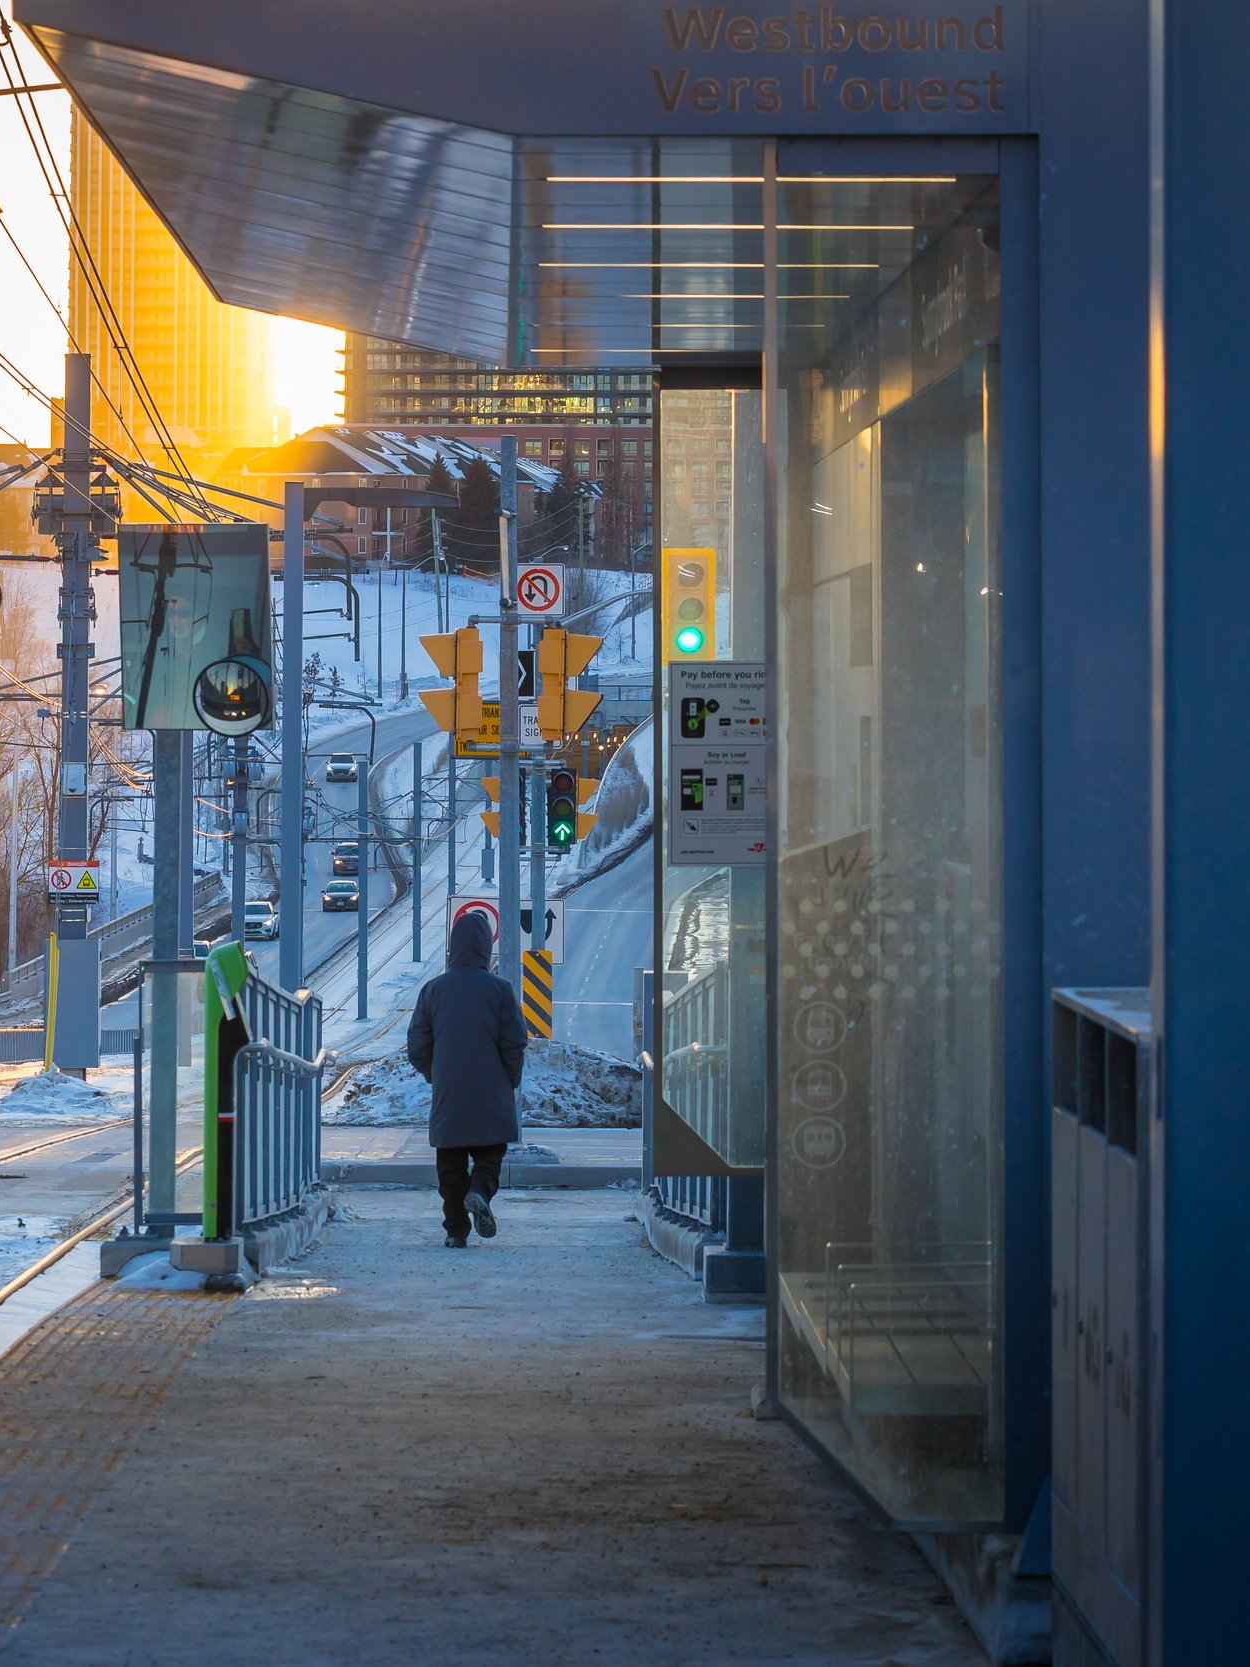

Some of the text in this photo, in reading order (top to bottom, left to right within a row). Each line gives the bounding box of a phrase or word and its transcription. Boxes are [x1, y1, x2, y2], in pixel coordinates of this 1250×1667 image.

[663, 5, 1005, 53] Westbound
[651, 66, 1007, 113] Vers l'ouest
[681, 670, 698, 681] Pay
[701, 670, 732, 679] before
[734, 671, 752, 680] you
[685, 682, 706, 691] Payez
[739, 698, 751, 706] Tap
[707, 751, 720, 759] Buy
